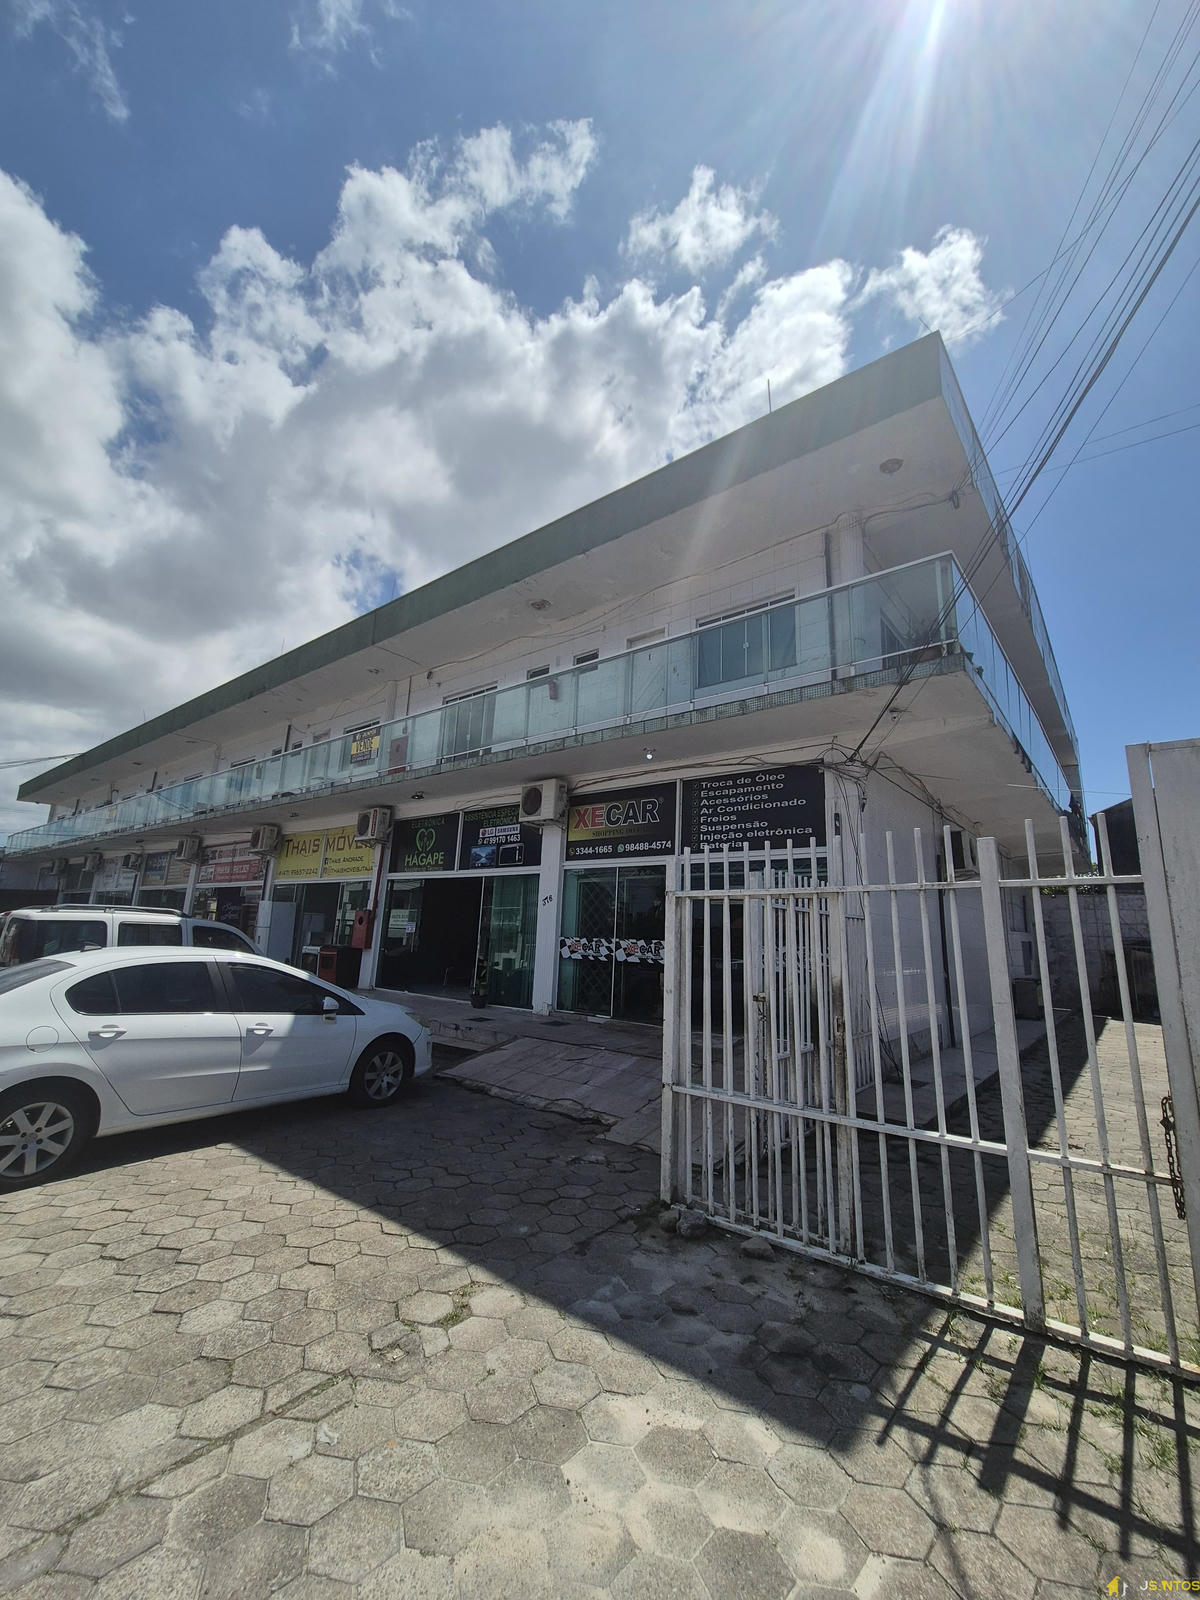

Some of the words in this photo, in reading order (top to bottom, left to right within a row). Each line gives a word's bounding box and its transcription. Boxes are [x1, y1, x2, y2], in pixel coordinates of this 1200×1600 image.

[701, 780, 733, 789] Troca
[737, 777, 752, 785] de
[755, 773, 785, 782] Óleo
[700, 783, 784, 797] Escapamento
[700, 793, 769, 806] Acessórios
[700, 807, 713, 815] Ar
[717, 798, 807, 813] Condicionado
[574, 799, 661, 830] XECAR
[700, 814, 737, 823] Freios
[700, 821, 769, 832] Suspensão
[700, 831, 743, 841] Injeção
[747, 827, 813, 837] eletrônica
[285, 838, 321, 857] THAIS
[575, 845, 613, 855] 3344-1665
[625, 840, 672, 852] 98488-4574
